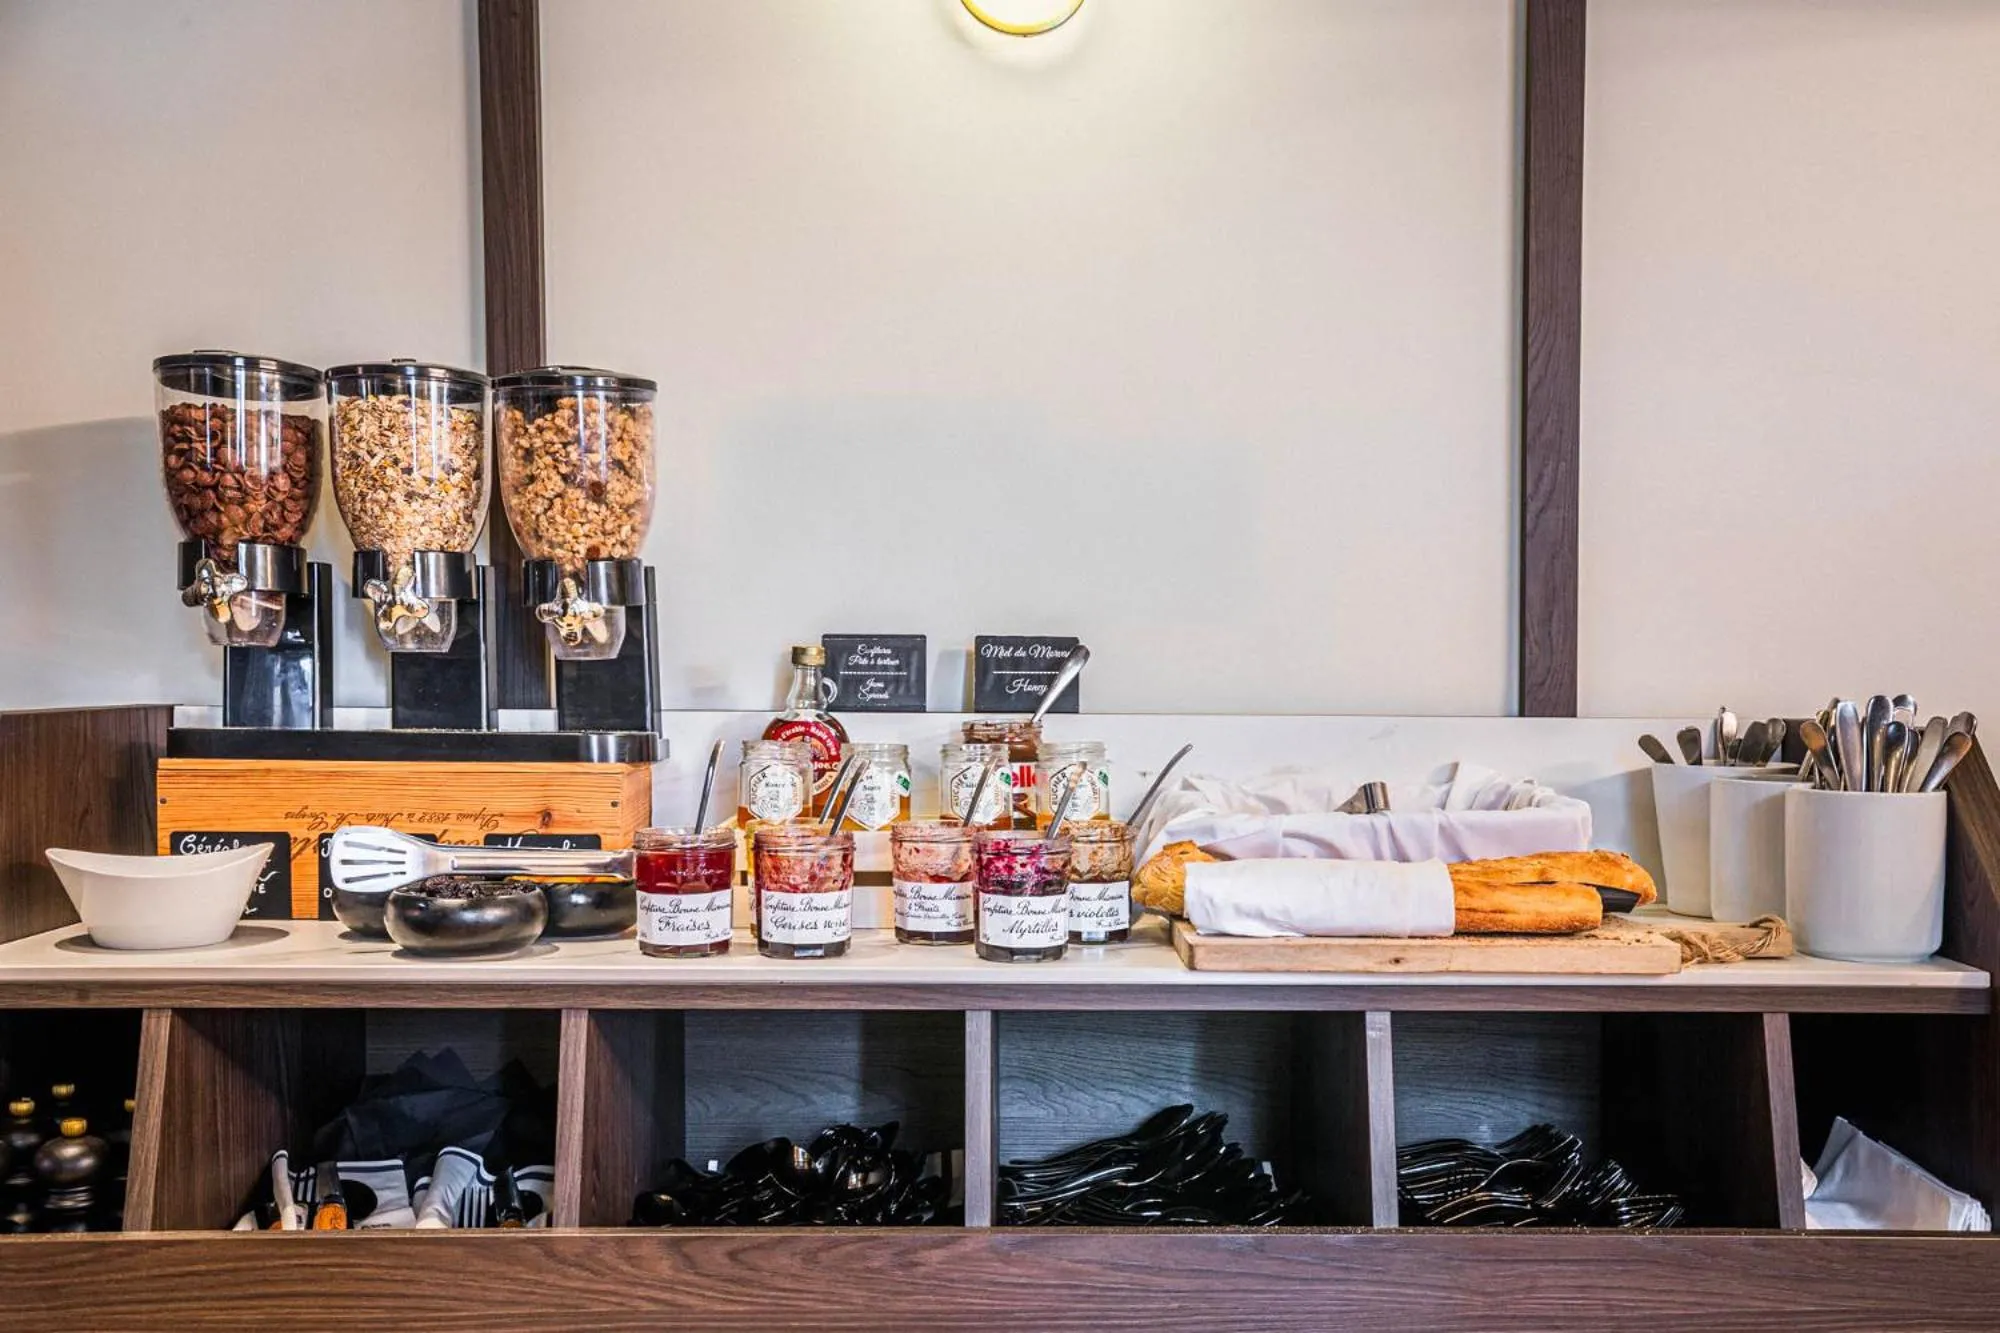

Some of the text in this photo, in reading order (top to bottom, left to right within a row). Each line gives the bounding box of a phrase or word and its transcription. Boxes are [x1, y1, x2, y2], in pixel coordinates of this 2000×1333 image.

[980, 643, 1012, 659] Miel
[1013, 646, 1027, 657] du
[1004, 678, 1048, 697] Honey
[669, 897, 700, 914] Bonne
[797, 896, 830, 912] Bonne
[1015, 899, 1047, 916] Bonne
[657, 915, 712, 932] Fraises
[769, 915, 819, 931] Cerises
[1001, 918, 1058, 939] Myrtilles
